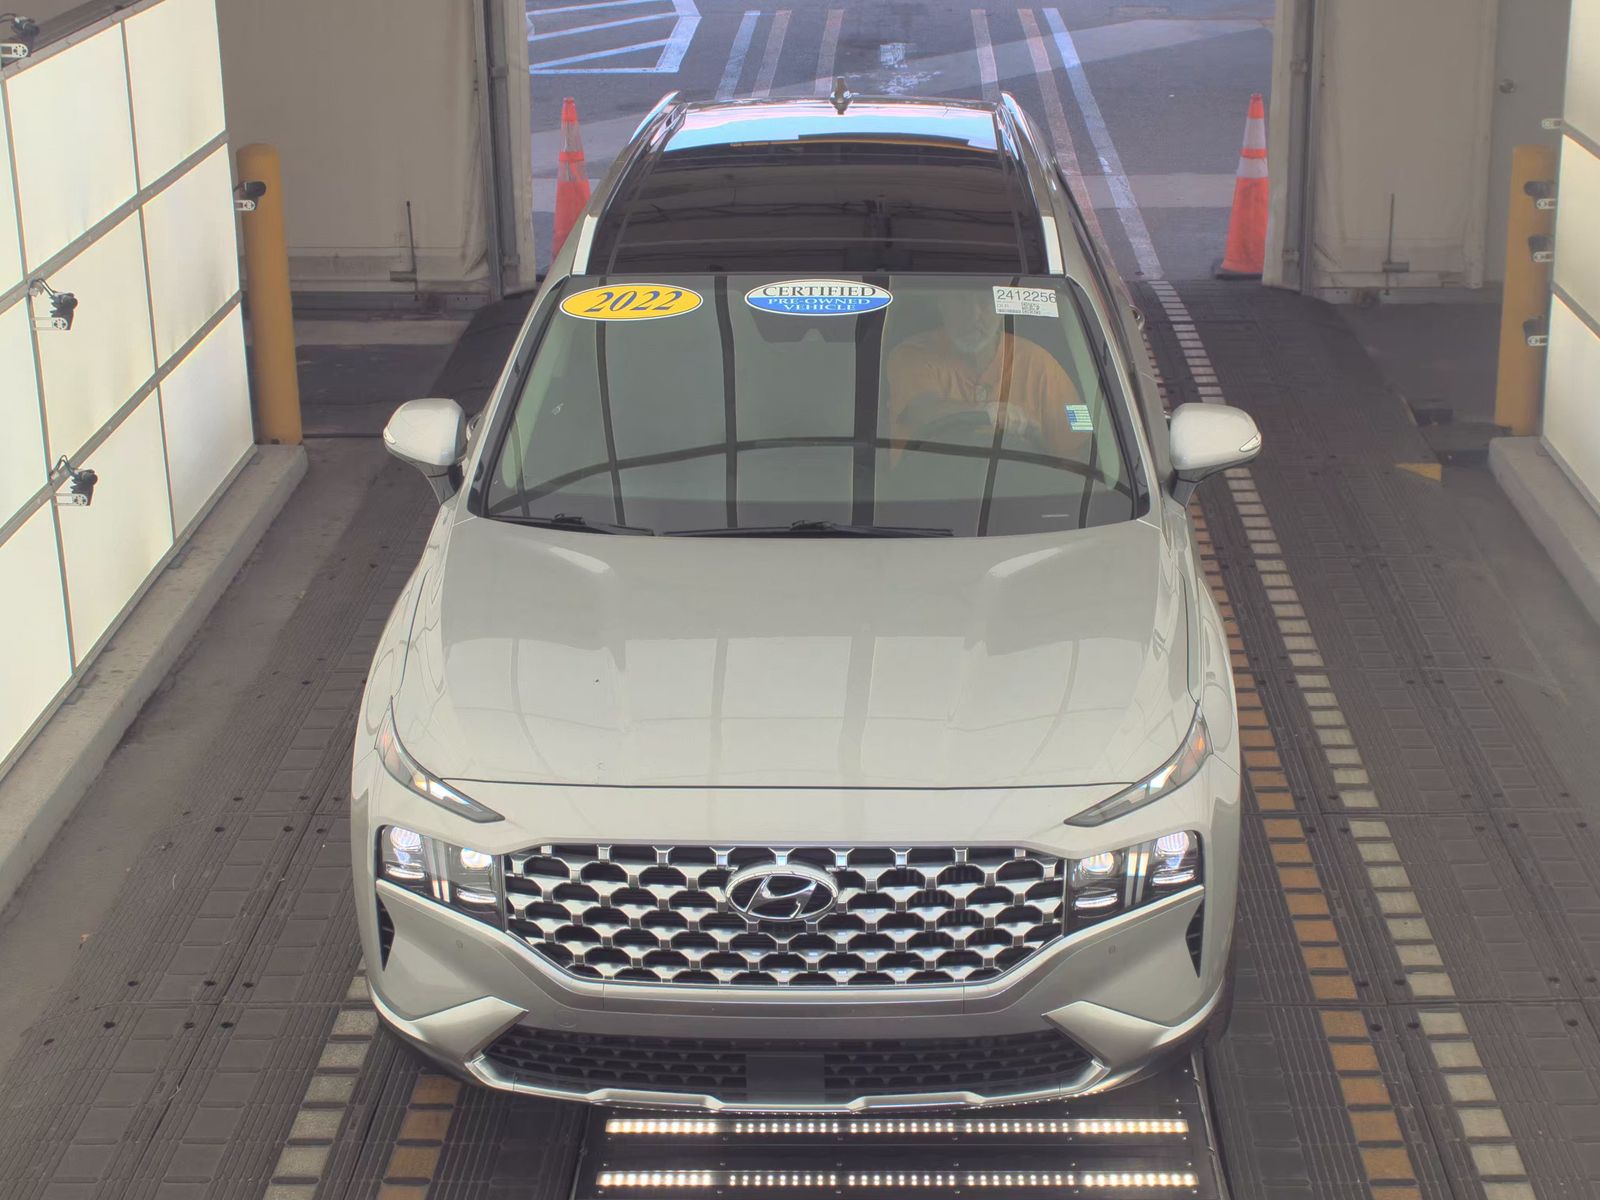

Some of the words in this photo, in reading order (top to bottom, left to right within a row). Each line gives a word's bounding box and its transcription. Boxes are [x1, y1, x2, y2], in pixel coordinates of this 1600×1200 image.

[763, 286, 876, 297] CERTIFIED
[997, 289, 1057, 303] 2412256
[584, 290, 683, 312] 2022
